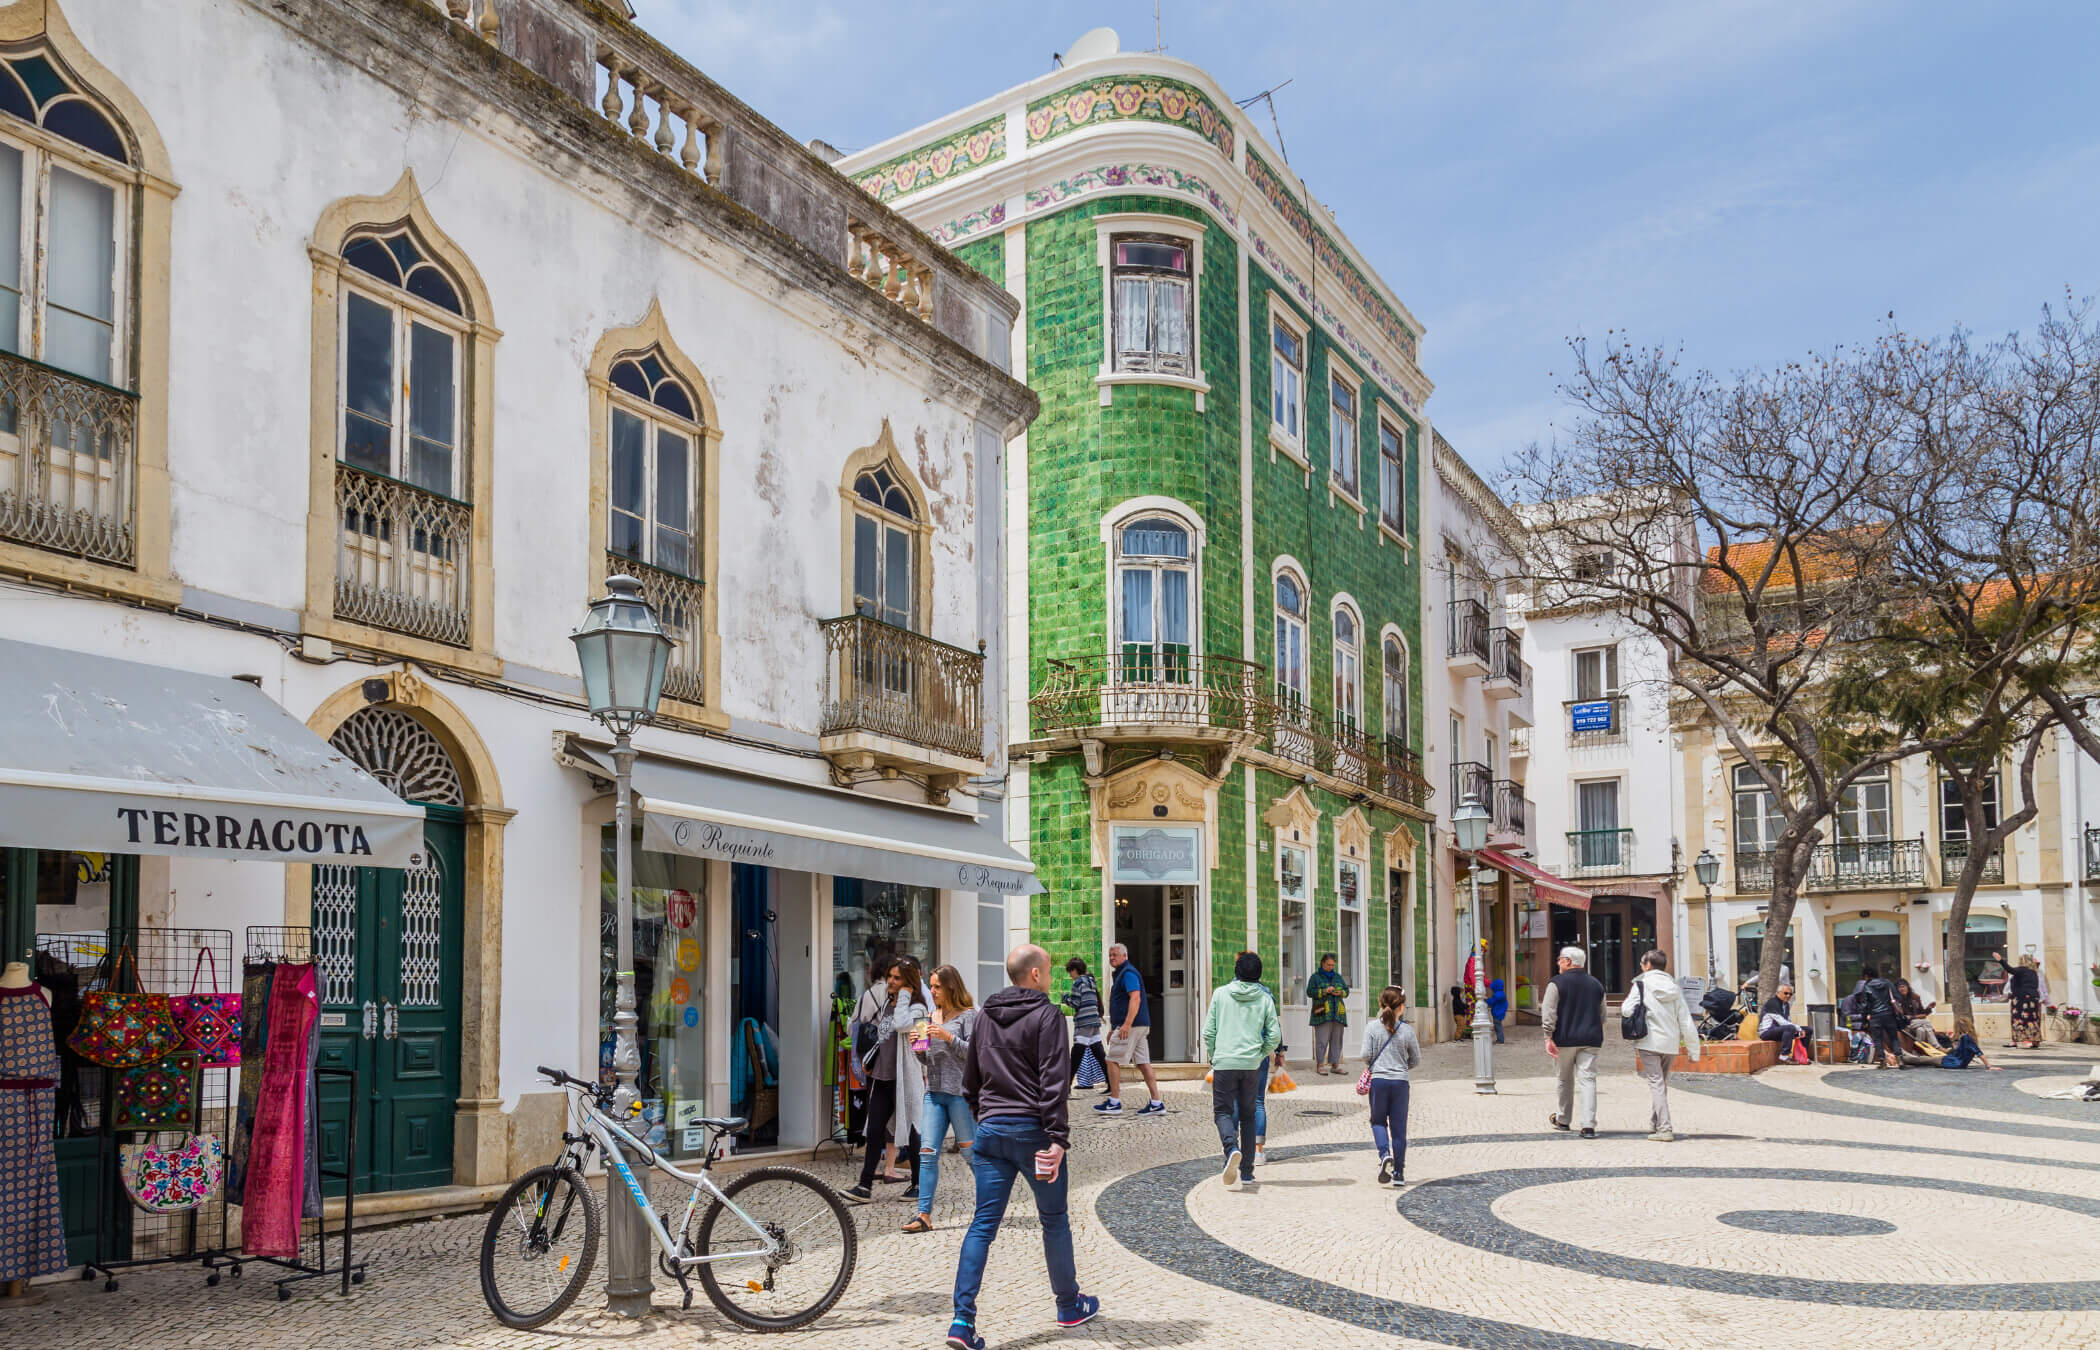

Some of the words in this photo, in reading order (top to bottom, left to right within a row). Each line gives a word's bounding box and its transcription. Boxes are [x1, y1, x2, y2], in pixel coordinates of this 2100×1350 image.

[117, 807, 373, 855] TERRACOTA
[672, 820, 691, 848] O
[702, 823, 776, 859] Requinte
[1126, 849, 1185, 861] OBRIGADO
[976, 867, 1025, 893] Requinte
[616, 1163, 646, 1207] BERG
